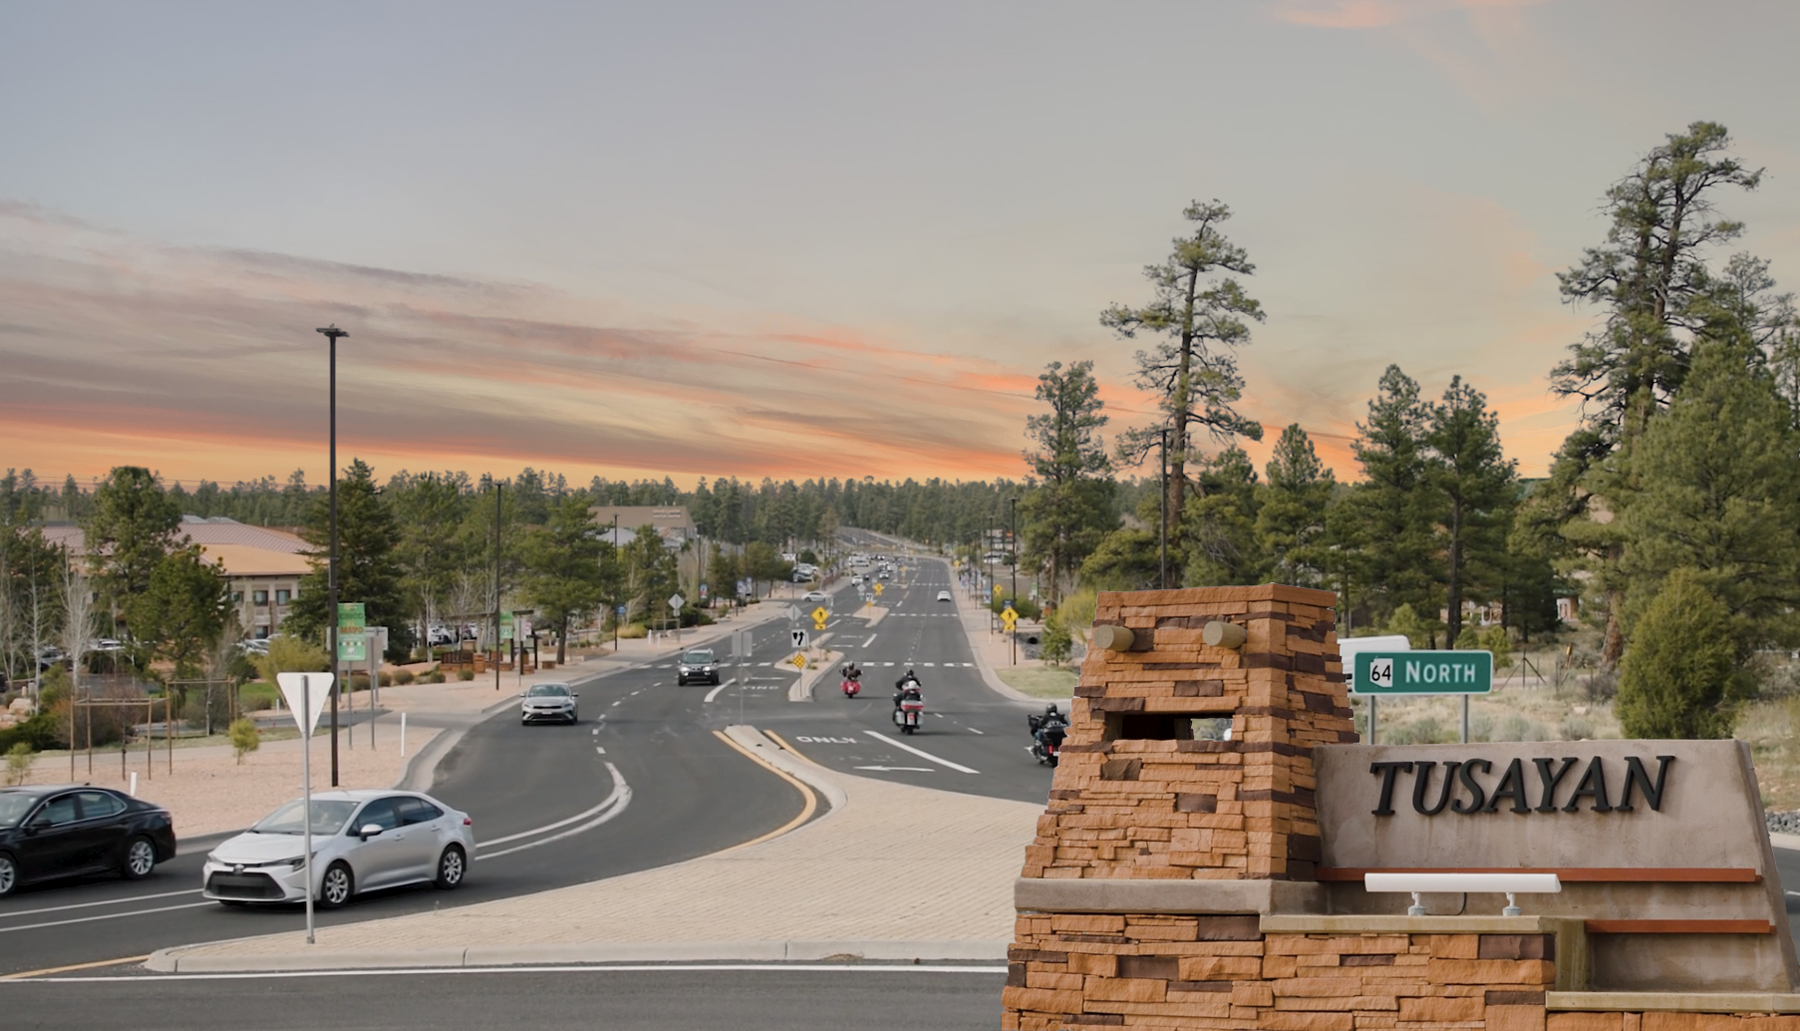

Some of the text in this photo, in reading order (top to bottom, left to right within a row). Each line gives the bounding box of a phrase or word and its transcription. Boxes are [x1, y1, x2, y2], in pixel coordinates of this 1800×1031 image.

[1371, 660, 1476, 683] 64 NORTH
[795, 735, 858, 744] ONLY
[1370, 755, 1676, 815] TUSAYAN
